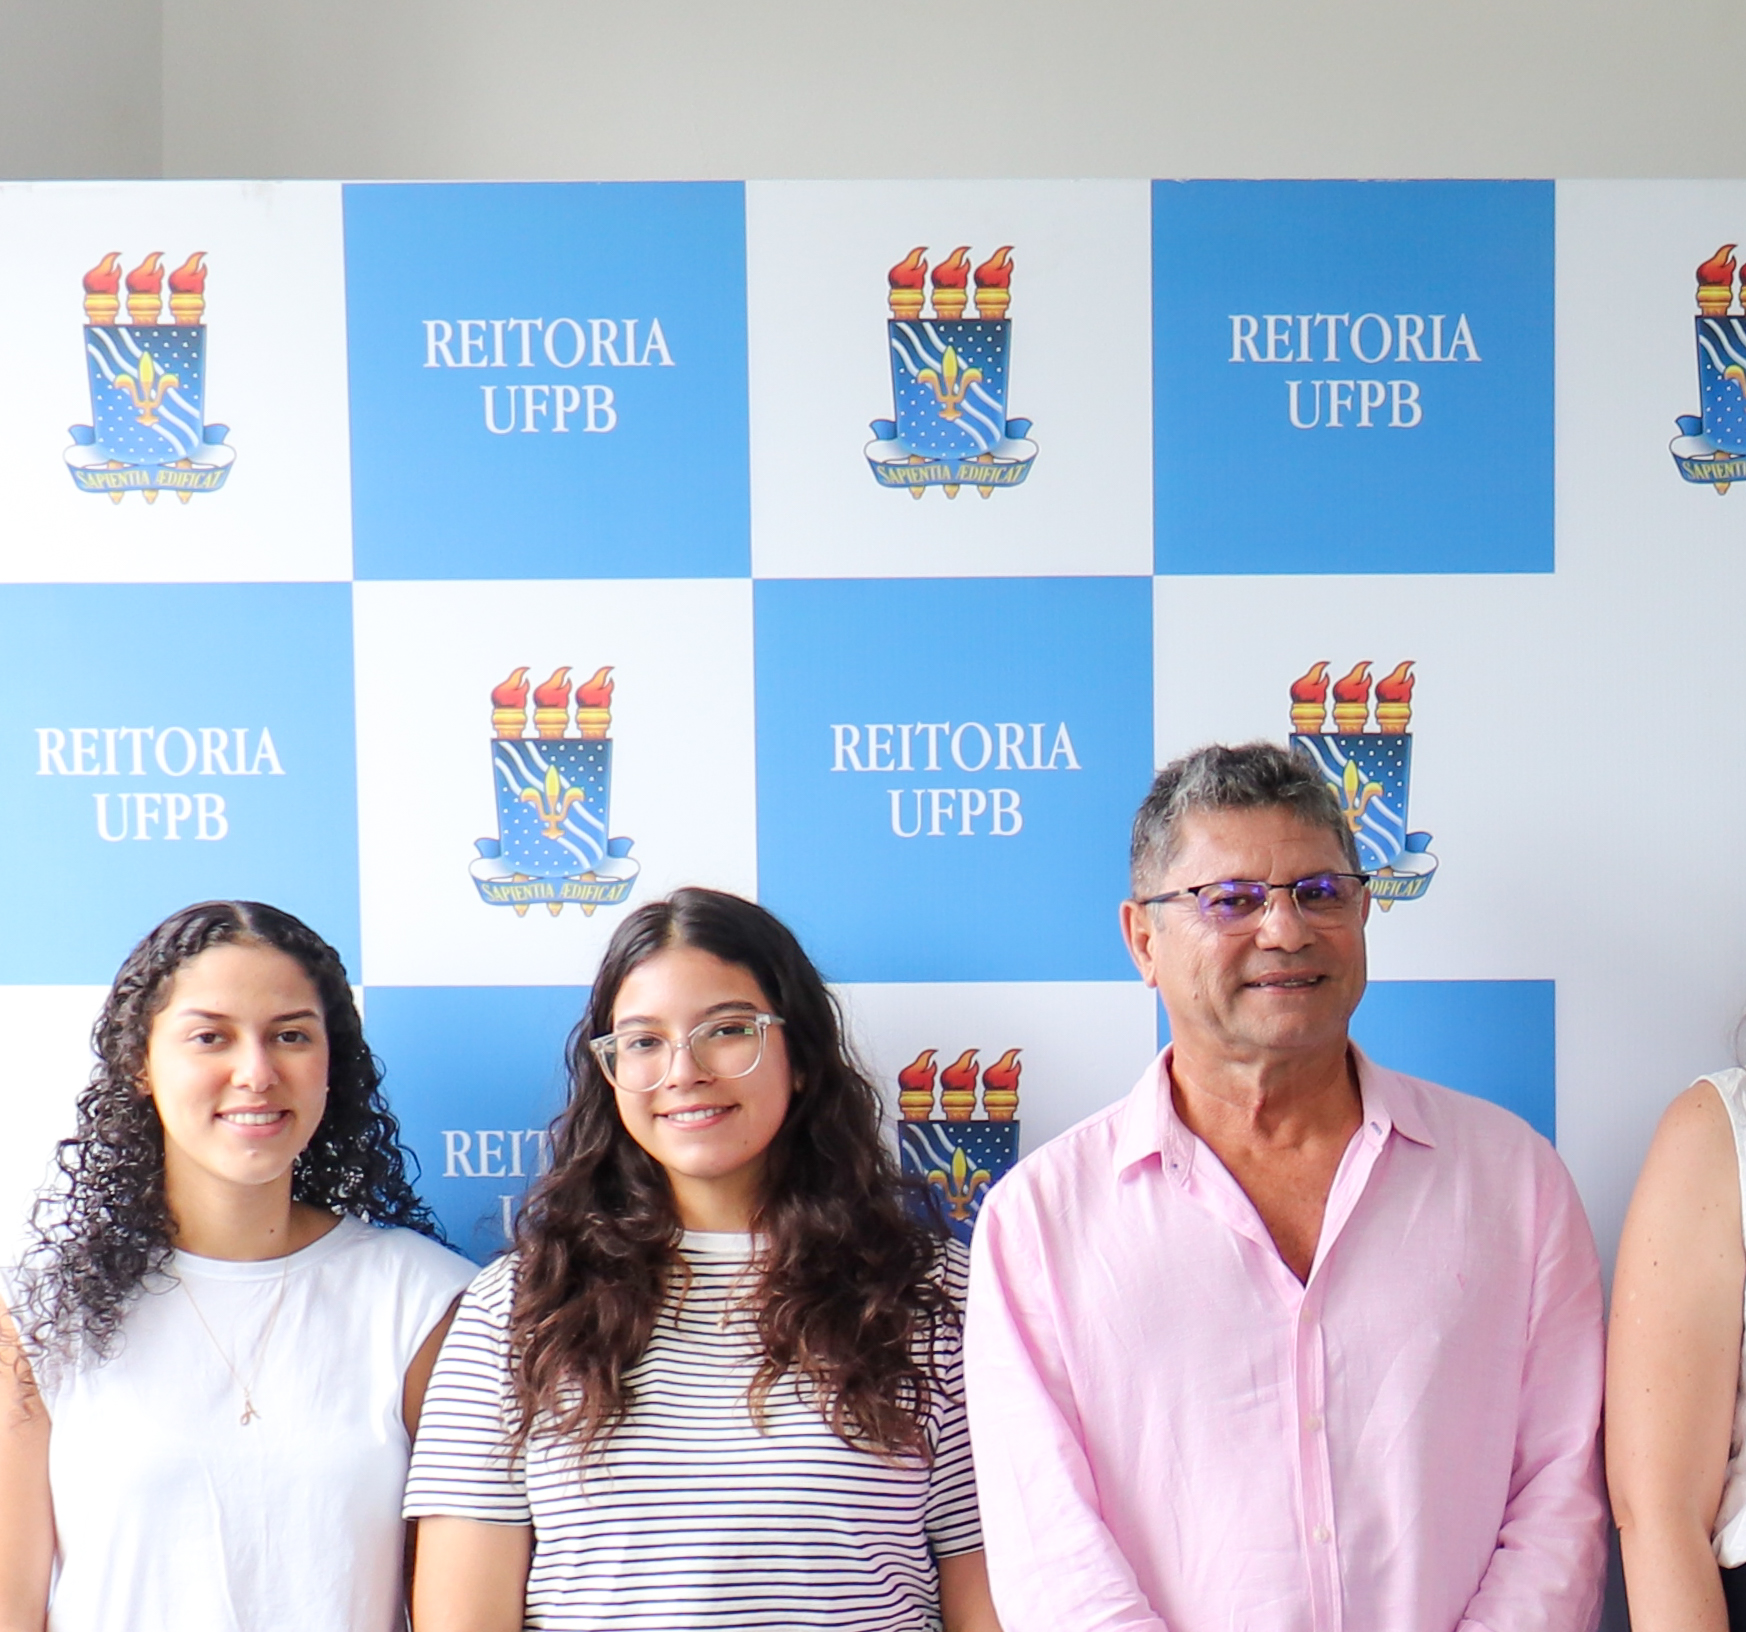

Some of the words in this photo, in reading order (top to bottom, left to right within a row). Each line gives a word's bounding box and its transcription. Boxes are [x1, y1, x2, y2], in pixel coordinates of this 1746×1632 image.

[423, 318, 675, 368] REITORIA
[1228, 313, 1482, 363] REITORIA
[481, 385, 617, 434] UFPB
[1286, 380, 1422, 429] UFPB
[75, 469, 147, 490] SAPIENTIA
[877, 463, 951, 484] SAPIENTIA
[36, 727, 285, 776] REITORIA
[831, 722, 1082, 772] REITORIA
[93, 793, 229, 842] UFPB
[887, 788, 1023, 838] UFPB
[481, 882, 554, 903] SAPIENTIA
[1369, 877, 1427, 898] DIFICAT
[441, 1129, 552, 1178] REIT
